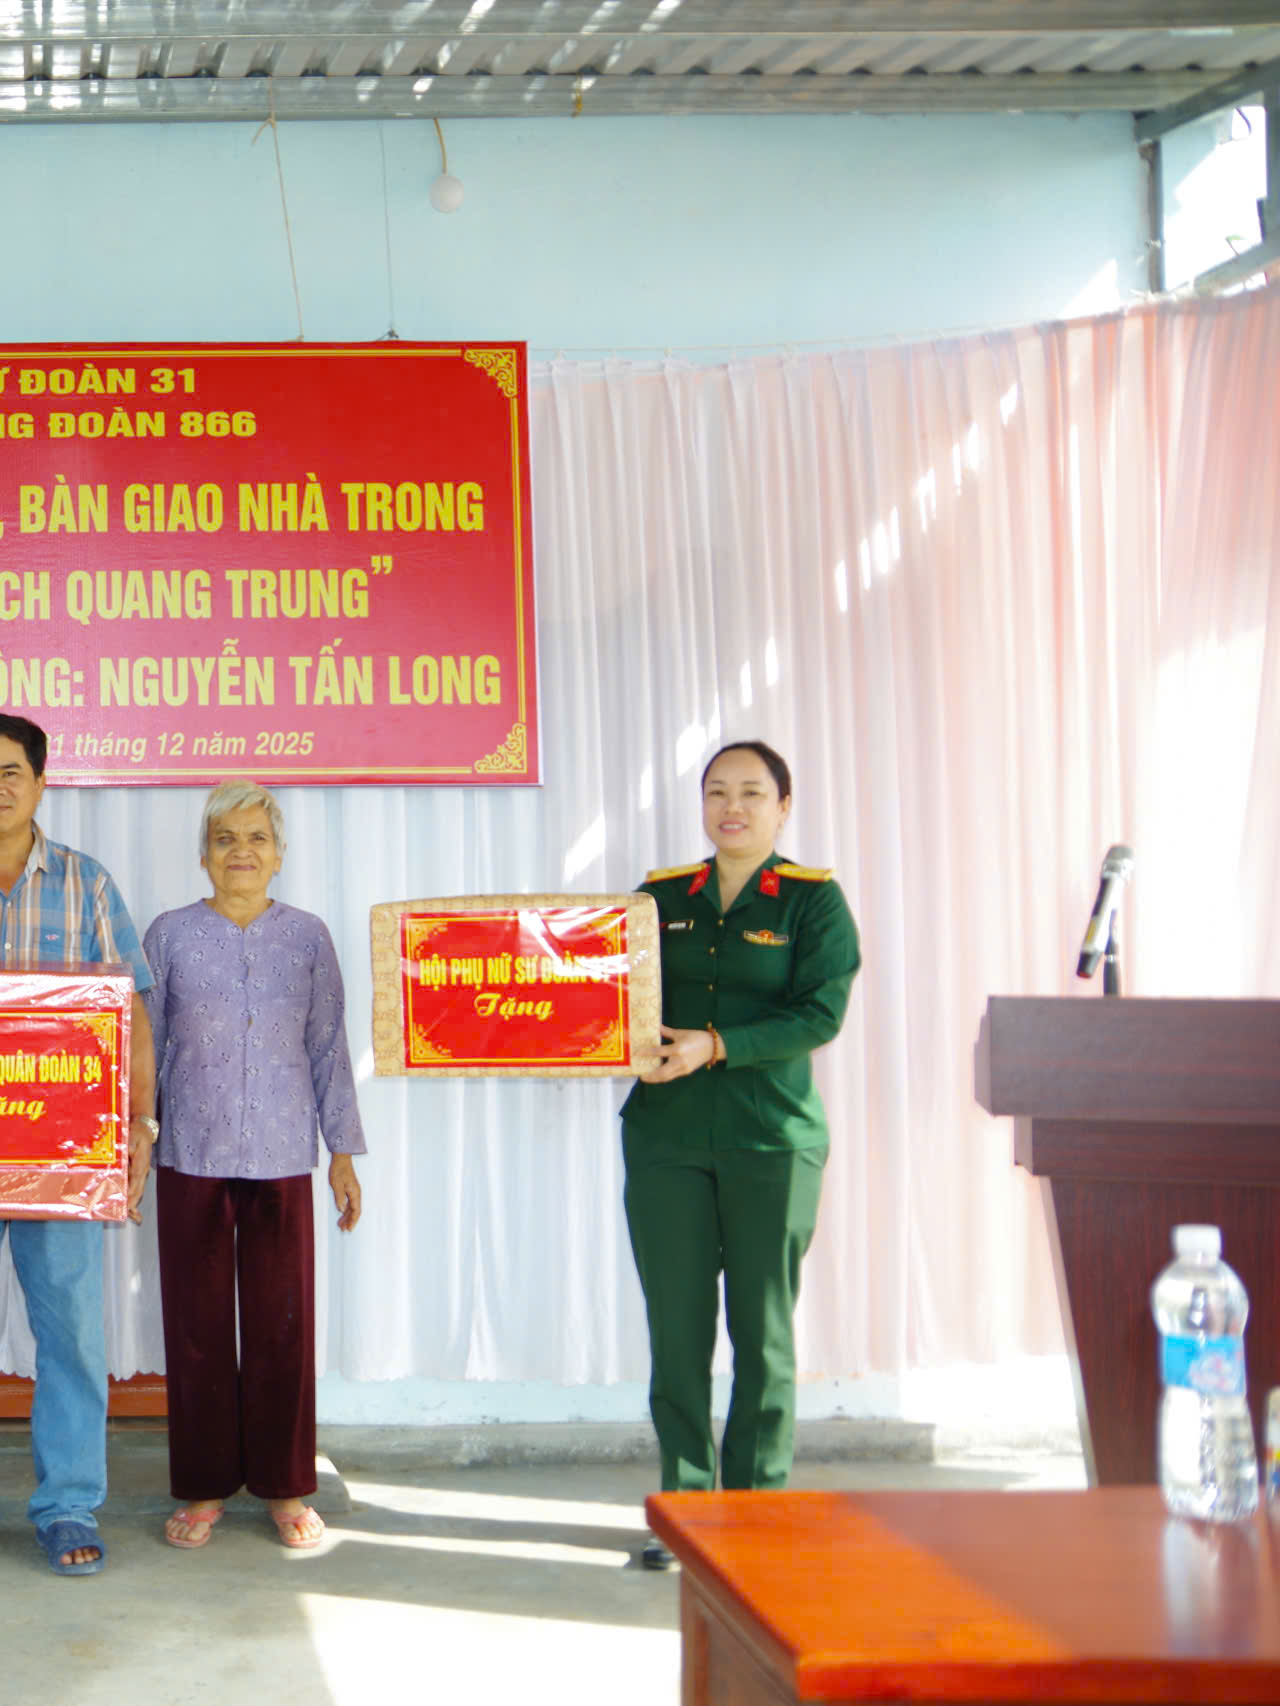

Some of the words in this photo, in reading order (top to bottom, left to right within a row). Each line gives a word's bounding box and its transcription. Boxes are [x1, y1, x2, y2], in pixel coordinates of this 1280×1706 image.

[19, 363, 136, 394] ĐOÀN
[150, 367, 196, 393] 31
[48, 407, 166, 438] ĐOÀN
[180, 411, 257, 437] 866
[20, 474, 108, 533] BÀN
[123, 482, 224, 533] GIAO
[238, 472, 329, 532] NHÀ
[341, 482, 484, 532] TRONG
[66, 569, 211, 625] QUANG
[225, 555, 393, 618] TRUNG”
[99, 637, 275, 706] NGUYỄN
[288, 637, 374, 705] TẤN
[388, 655, 501, 705] LONG
[74, 731, 147, 762] tháng
[157, 732, 185, 755] 12
[192, 731, 247, 756] năm
[254, 731, 315, 755] 2025
[419, 952, 447, 992] HỘI
[450, 956, 484, 991] PHỤ
[487, 951, 513, 985] NỮ
[474, 993, 554, 1022] Tặng
[39, 1048, 81, 1083] ĐOÀN
[83, 1054, 102, 1083] 34
